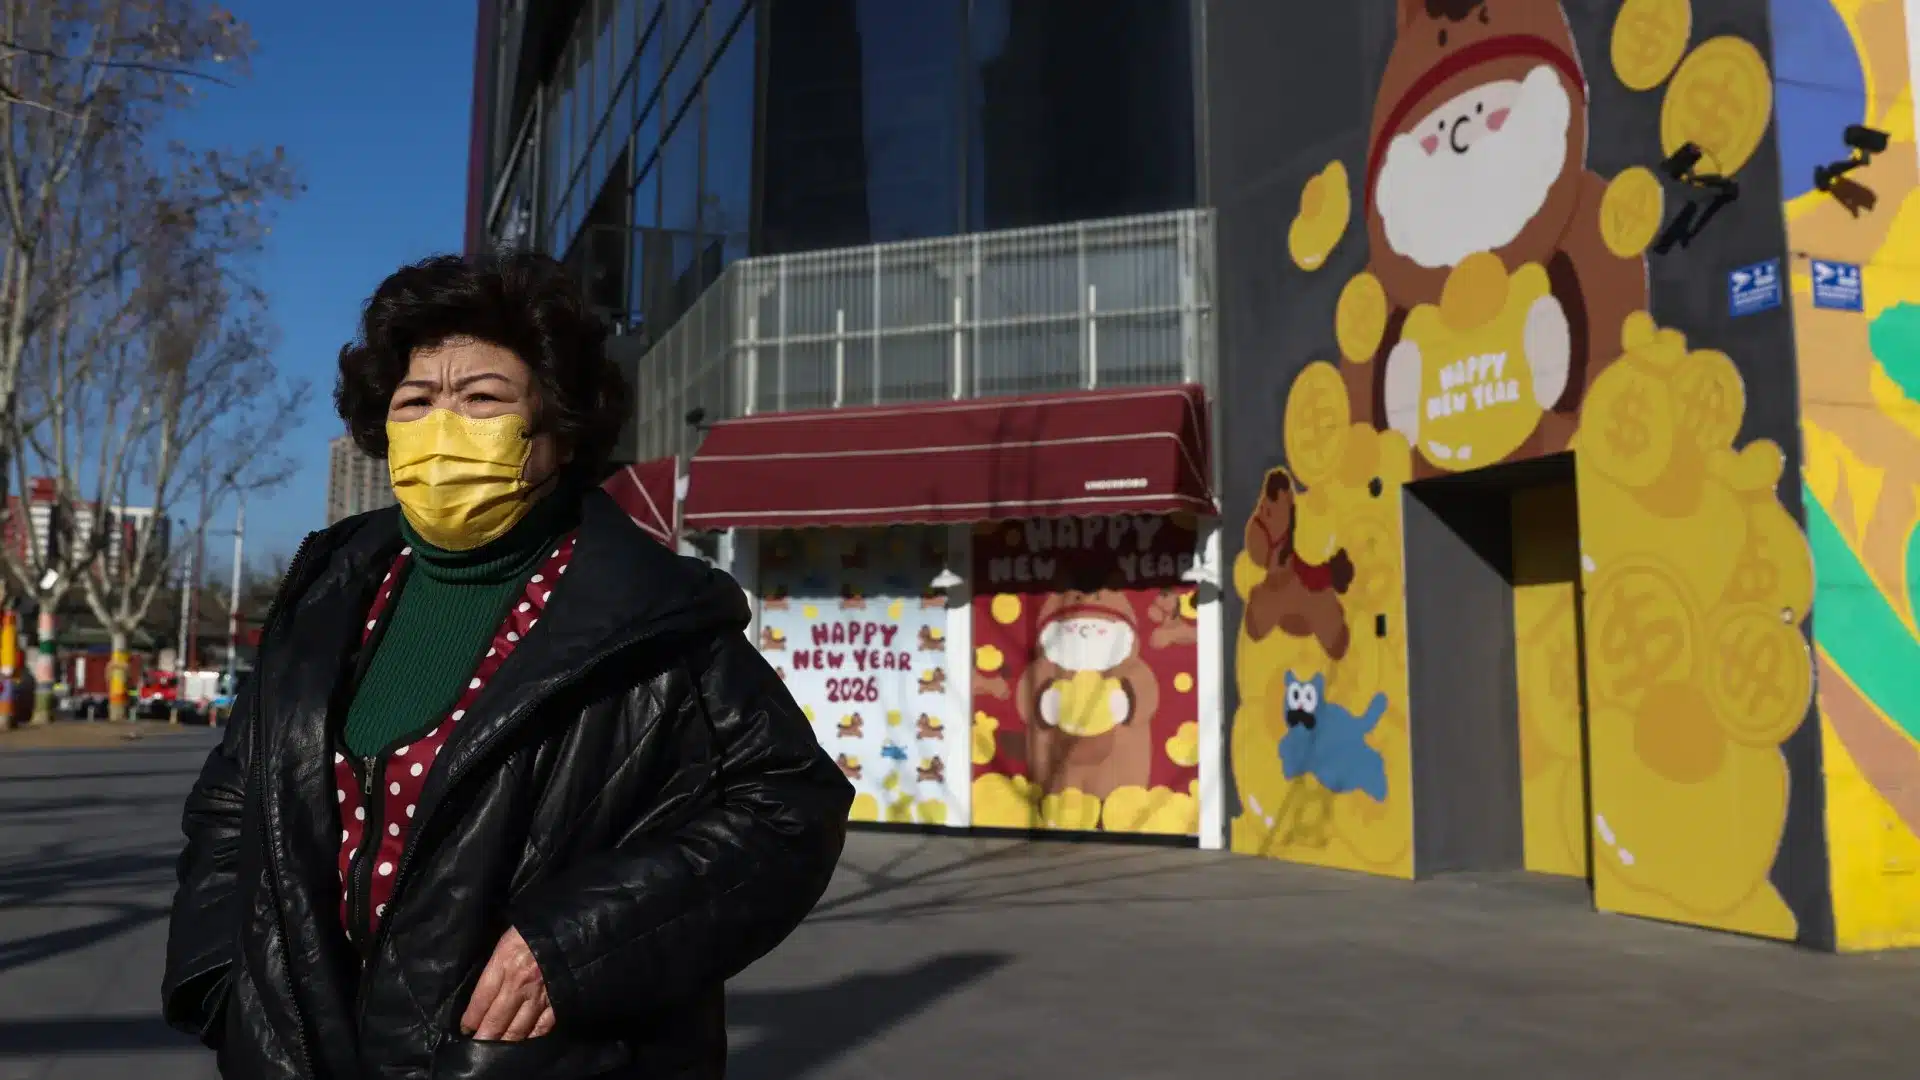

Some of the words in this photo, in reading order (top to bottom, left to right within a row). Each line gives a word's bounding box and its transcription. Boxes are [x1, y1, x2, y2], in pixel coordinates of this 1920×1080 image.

[1439, 350, 1506, 391] HAPPY
[1427, 391, 1467, 421] NEW
[1472, 378, 1520, 410] YEAR
[1024, 514, 1163, 552] HAPPY
[988, 553, 1057, 583] NEW
[811, 621, 898, 648] HAPPY
[793, 649, 845, 671] NEW
[853, 647, 912, 672] YEAR
[826, 675, 878, 703] 2026
